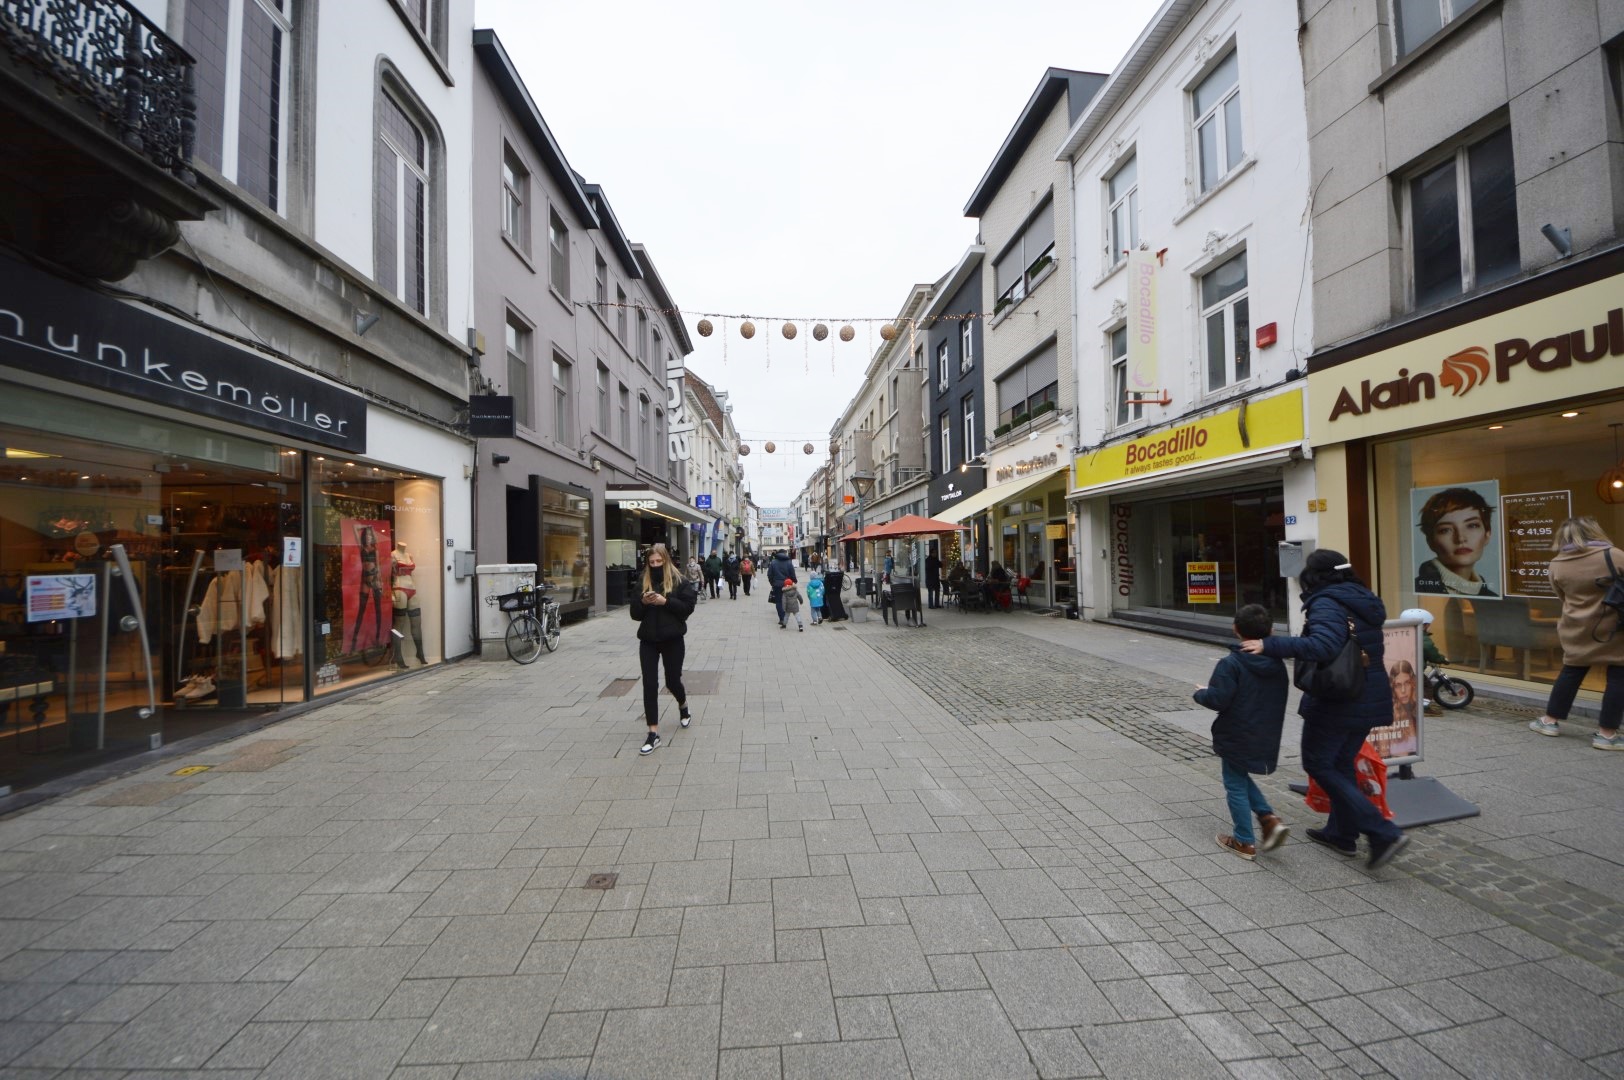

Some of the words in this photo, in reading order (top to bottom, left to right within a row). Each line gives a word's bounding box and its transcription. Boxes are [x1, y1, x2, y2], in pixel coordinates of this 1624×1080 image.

[1140, 263, 1155, 345] Bocadillo
[1328, 367, 1436, 422] Alain
[1494, 307, 1624, 383] Paul
[1126, 426, 1208, 465] Bocadillo
[1130, 463, 1151, 474] always
[1153, 458, 1174, 469] tastes
[1117, 504, 1135, 596] Bocadillo
[1526, 527, 1552, 536] 41,95
[1519, 568, 1526, 576] €
[1528, 568, 1549, 576] 27,9
